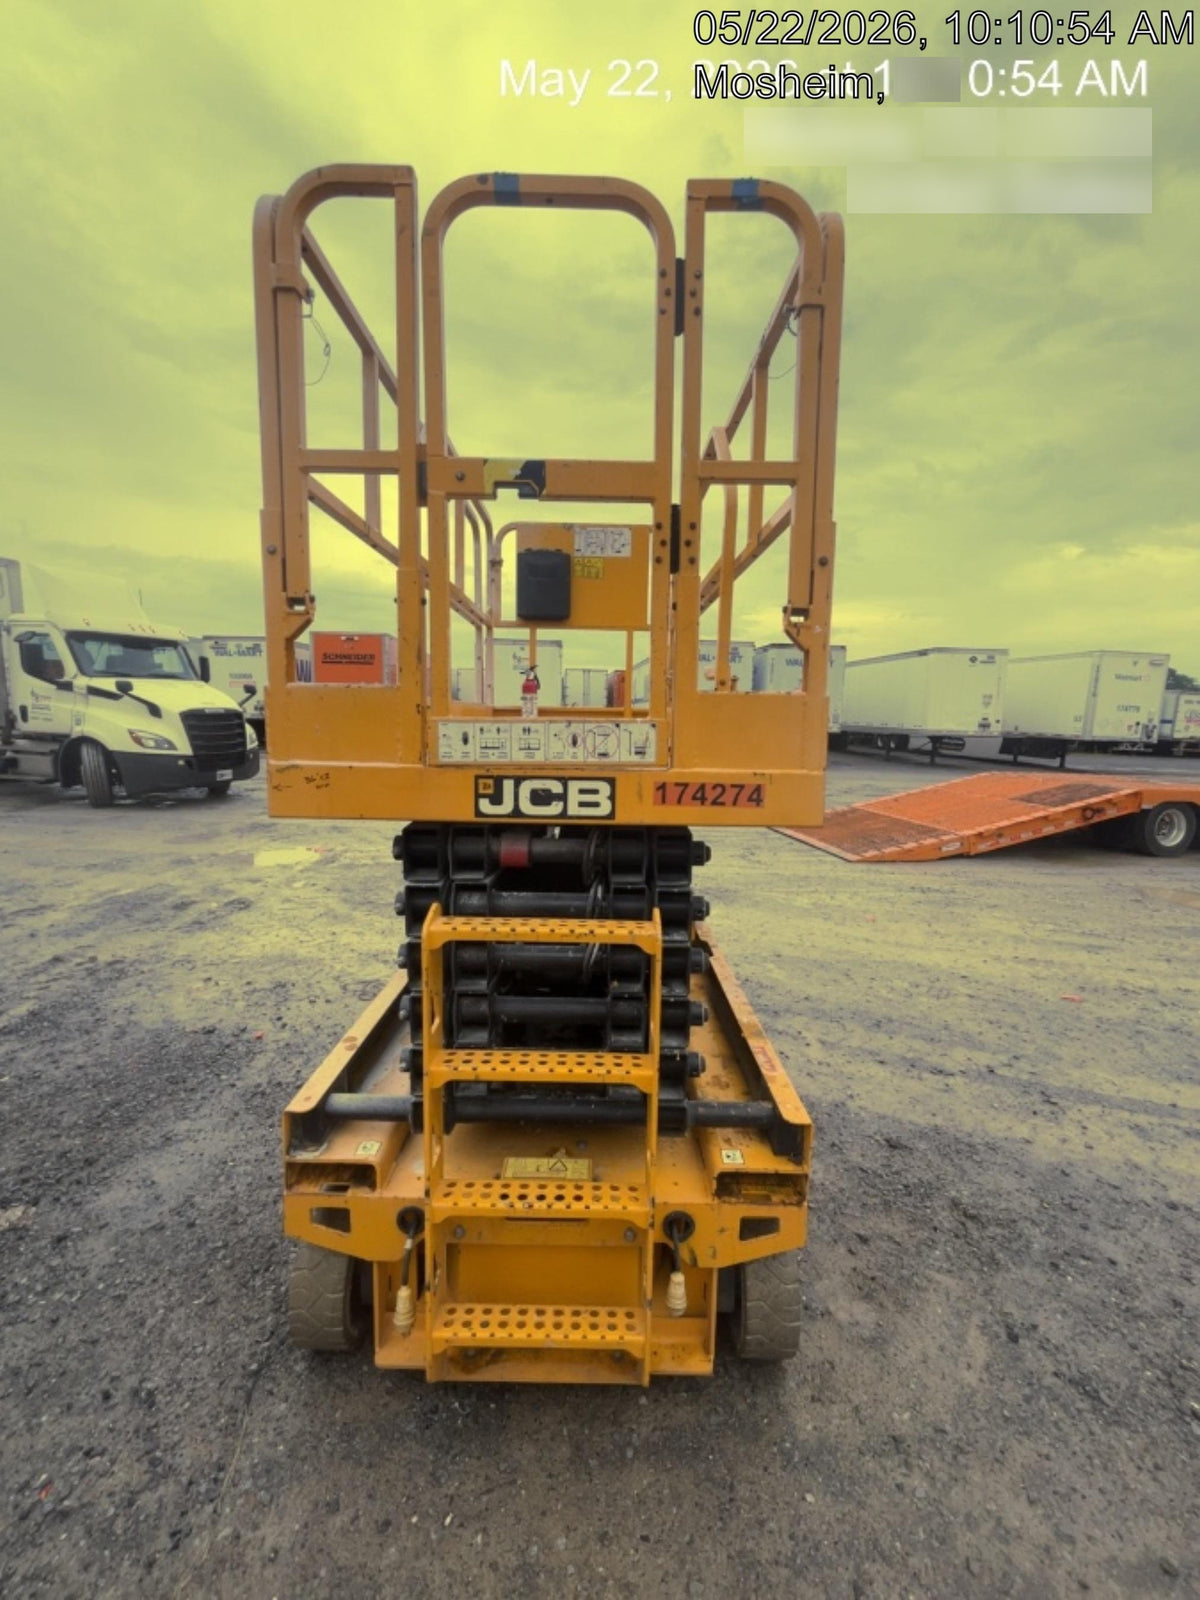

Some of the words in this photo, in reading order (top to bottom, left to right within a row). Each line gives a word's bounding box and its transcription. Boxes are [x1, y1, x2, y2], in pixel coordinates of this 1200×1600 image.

[322, 652, 376, 661] SCHNEIDER
[478, 778, 613, 816] JCB
[655, 781, 765, 807] 174274
